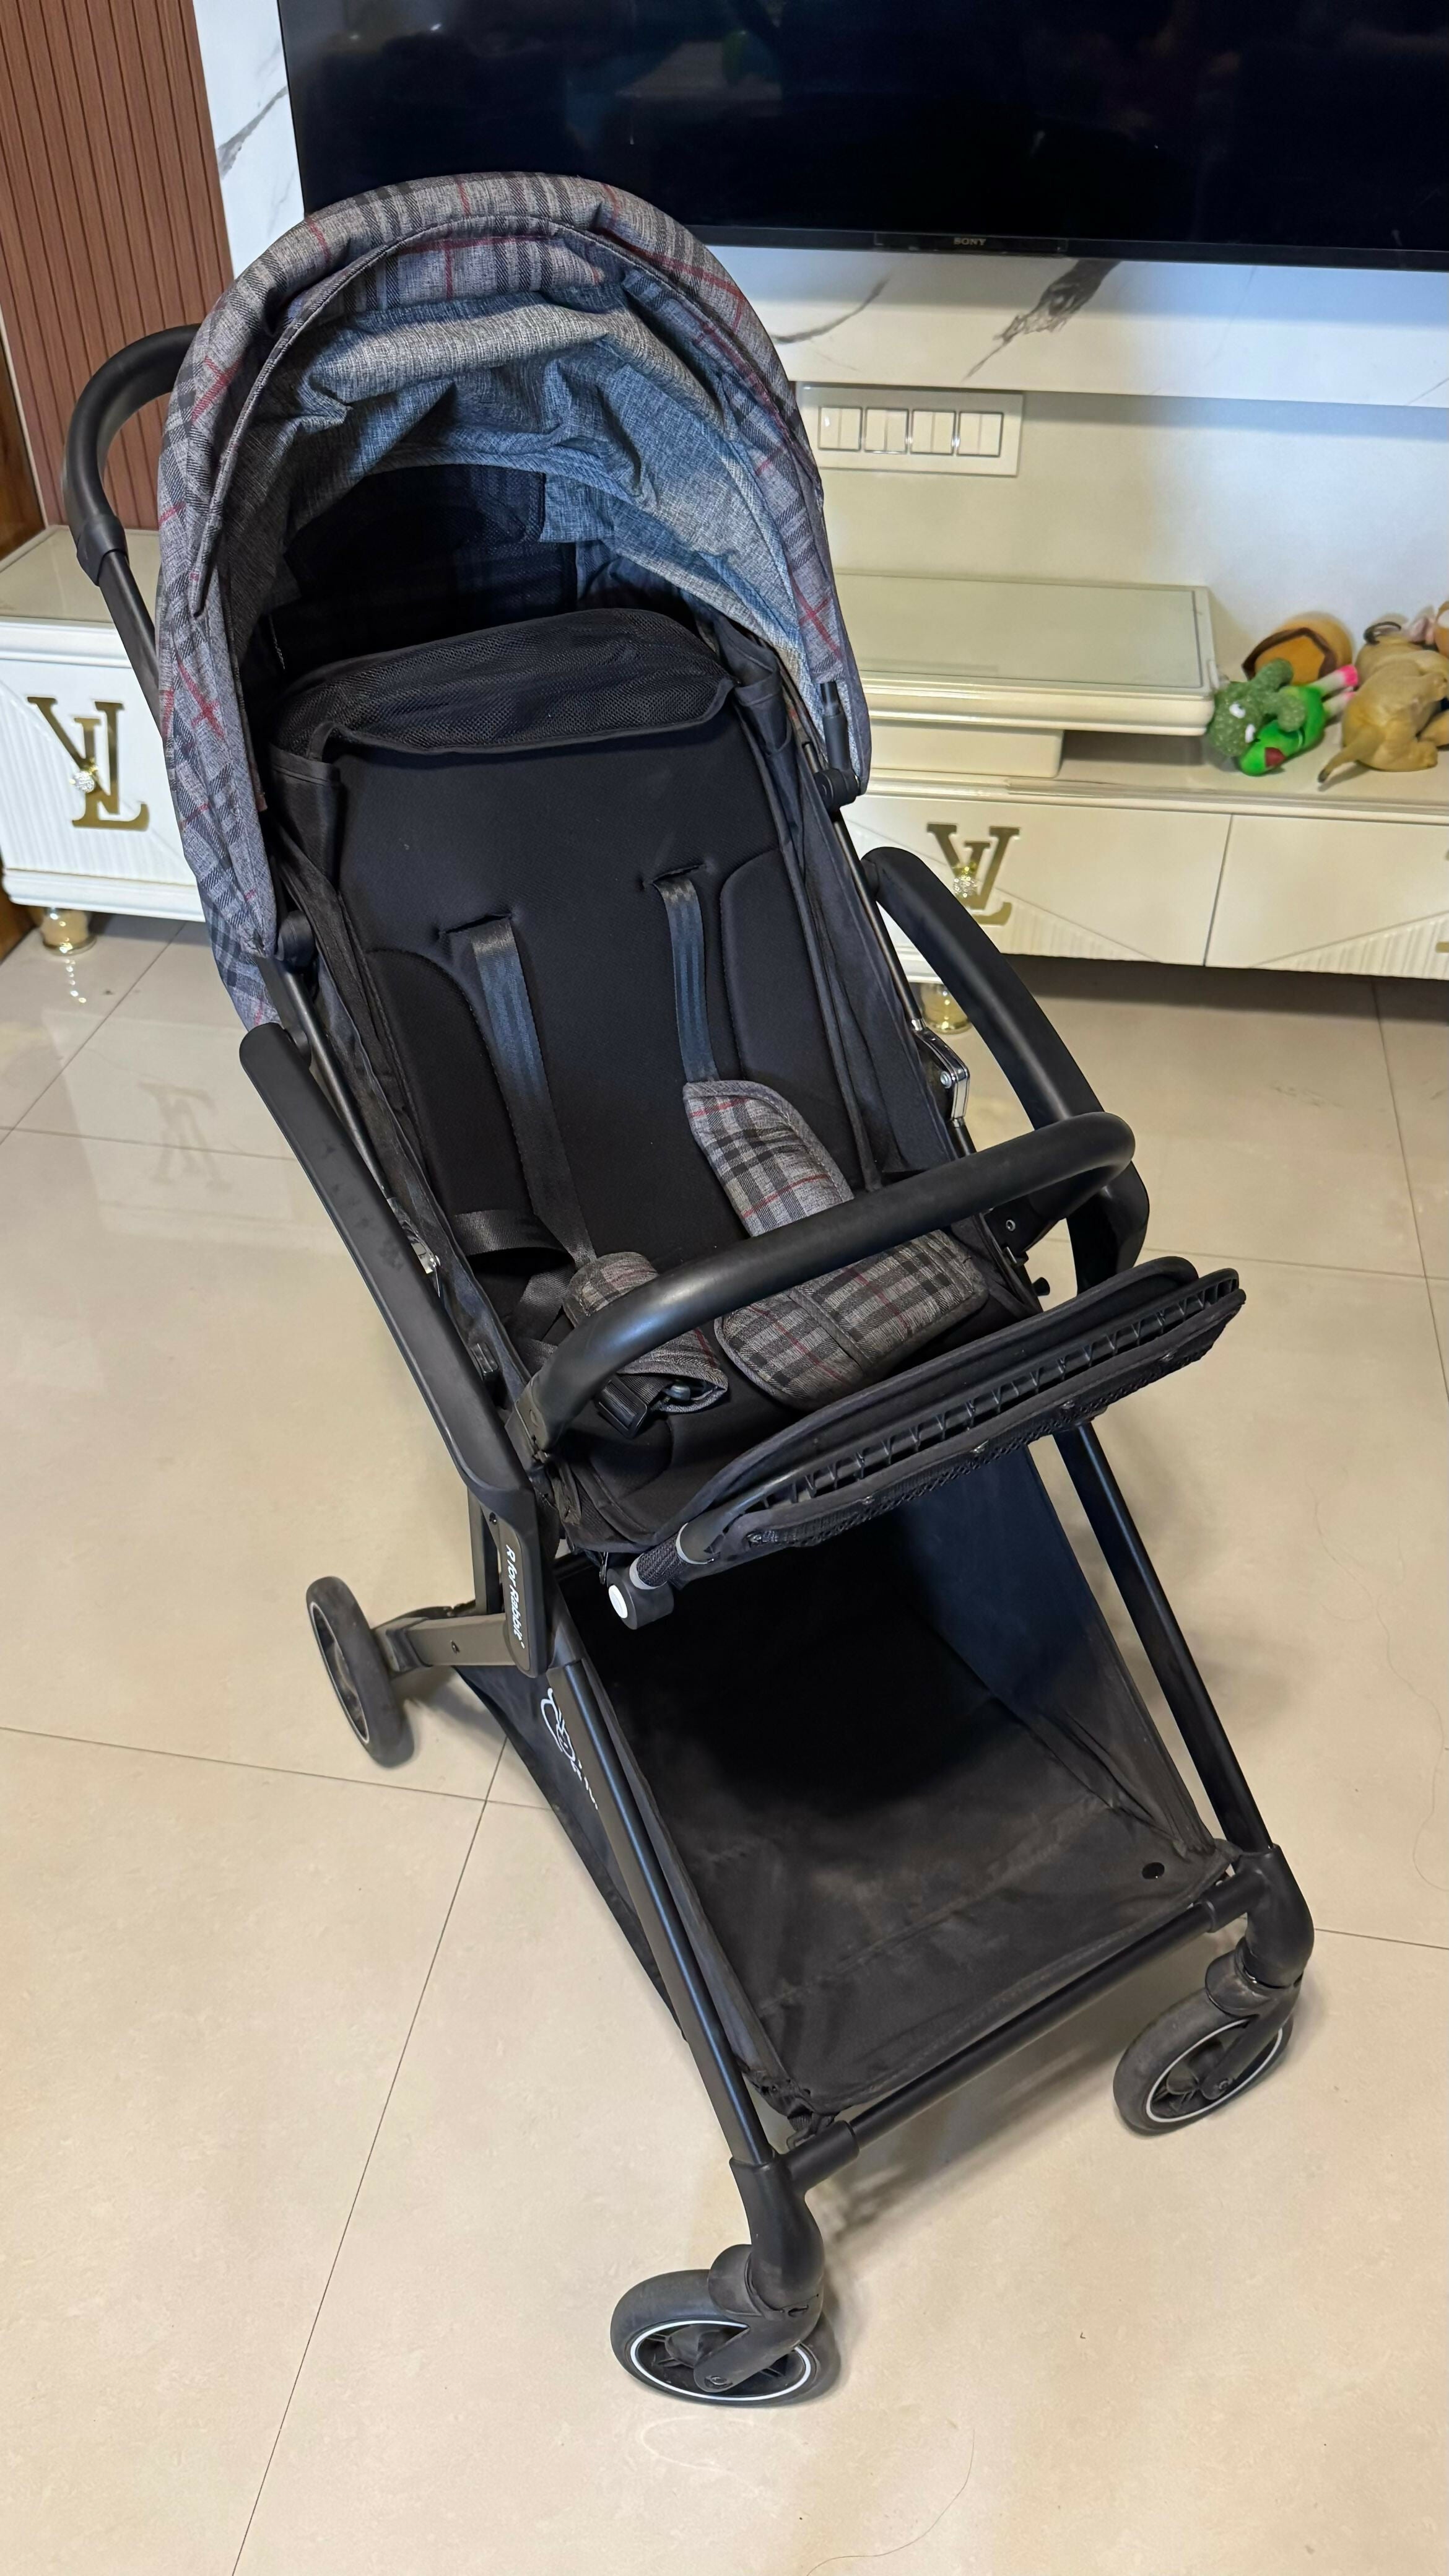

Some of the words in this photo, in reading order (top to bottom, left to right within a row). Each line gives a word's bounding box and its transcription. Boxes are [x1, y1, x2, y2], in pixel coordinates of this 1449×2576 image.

[953, 237, 986, 245] SONY
[505, 1544, 516, 1563] R
[507, 1559, 518, 1588] for
[509, 1585, 523, 1641] Rabbit
